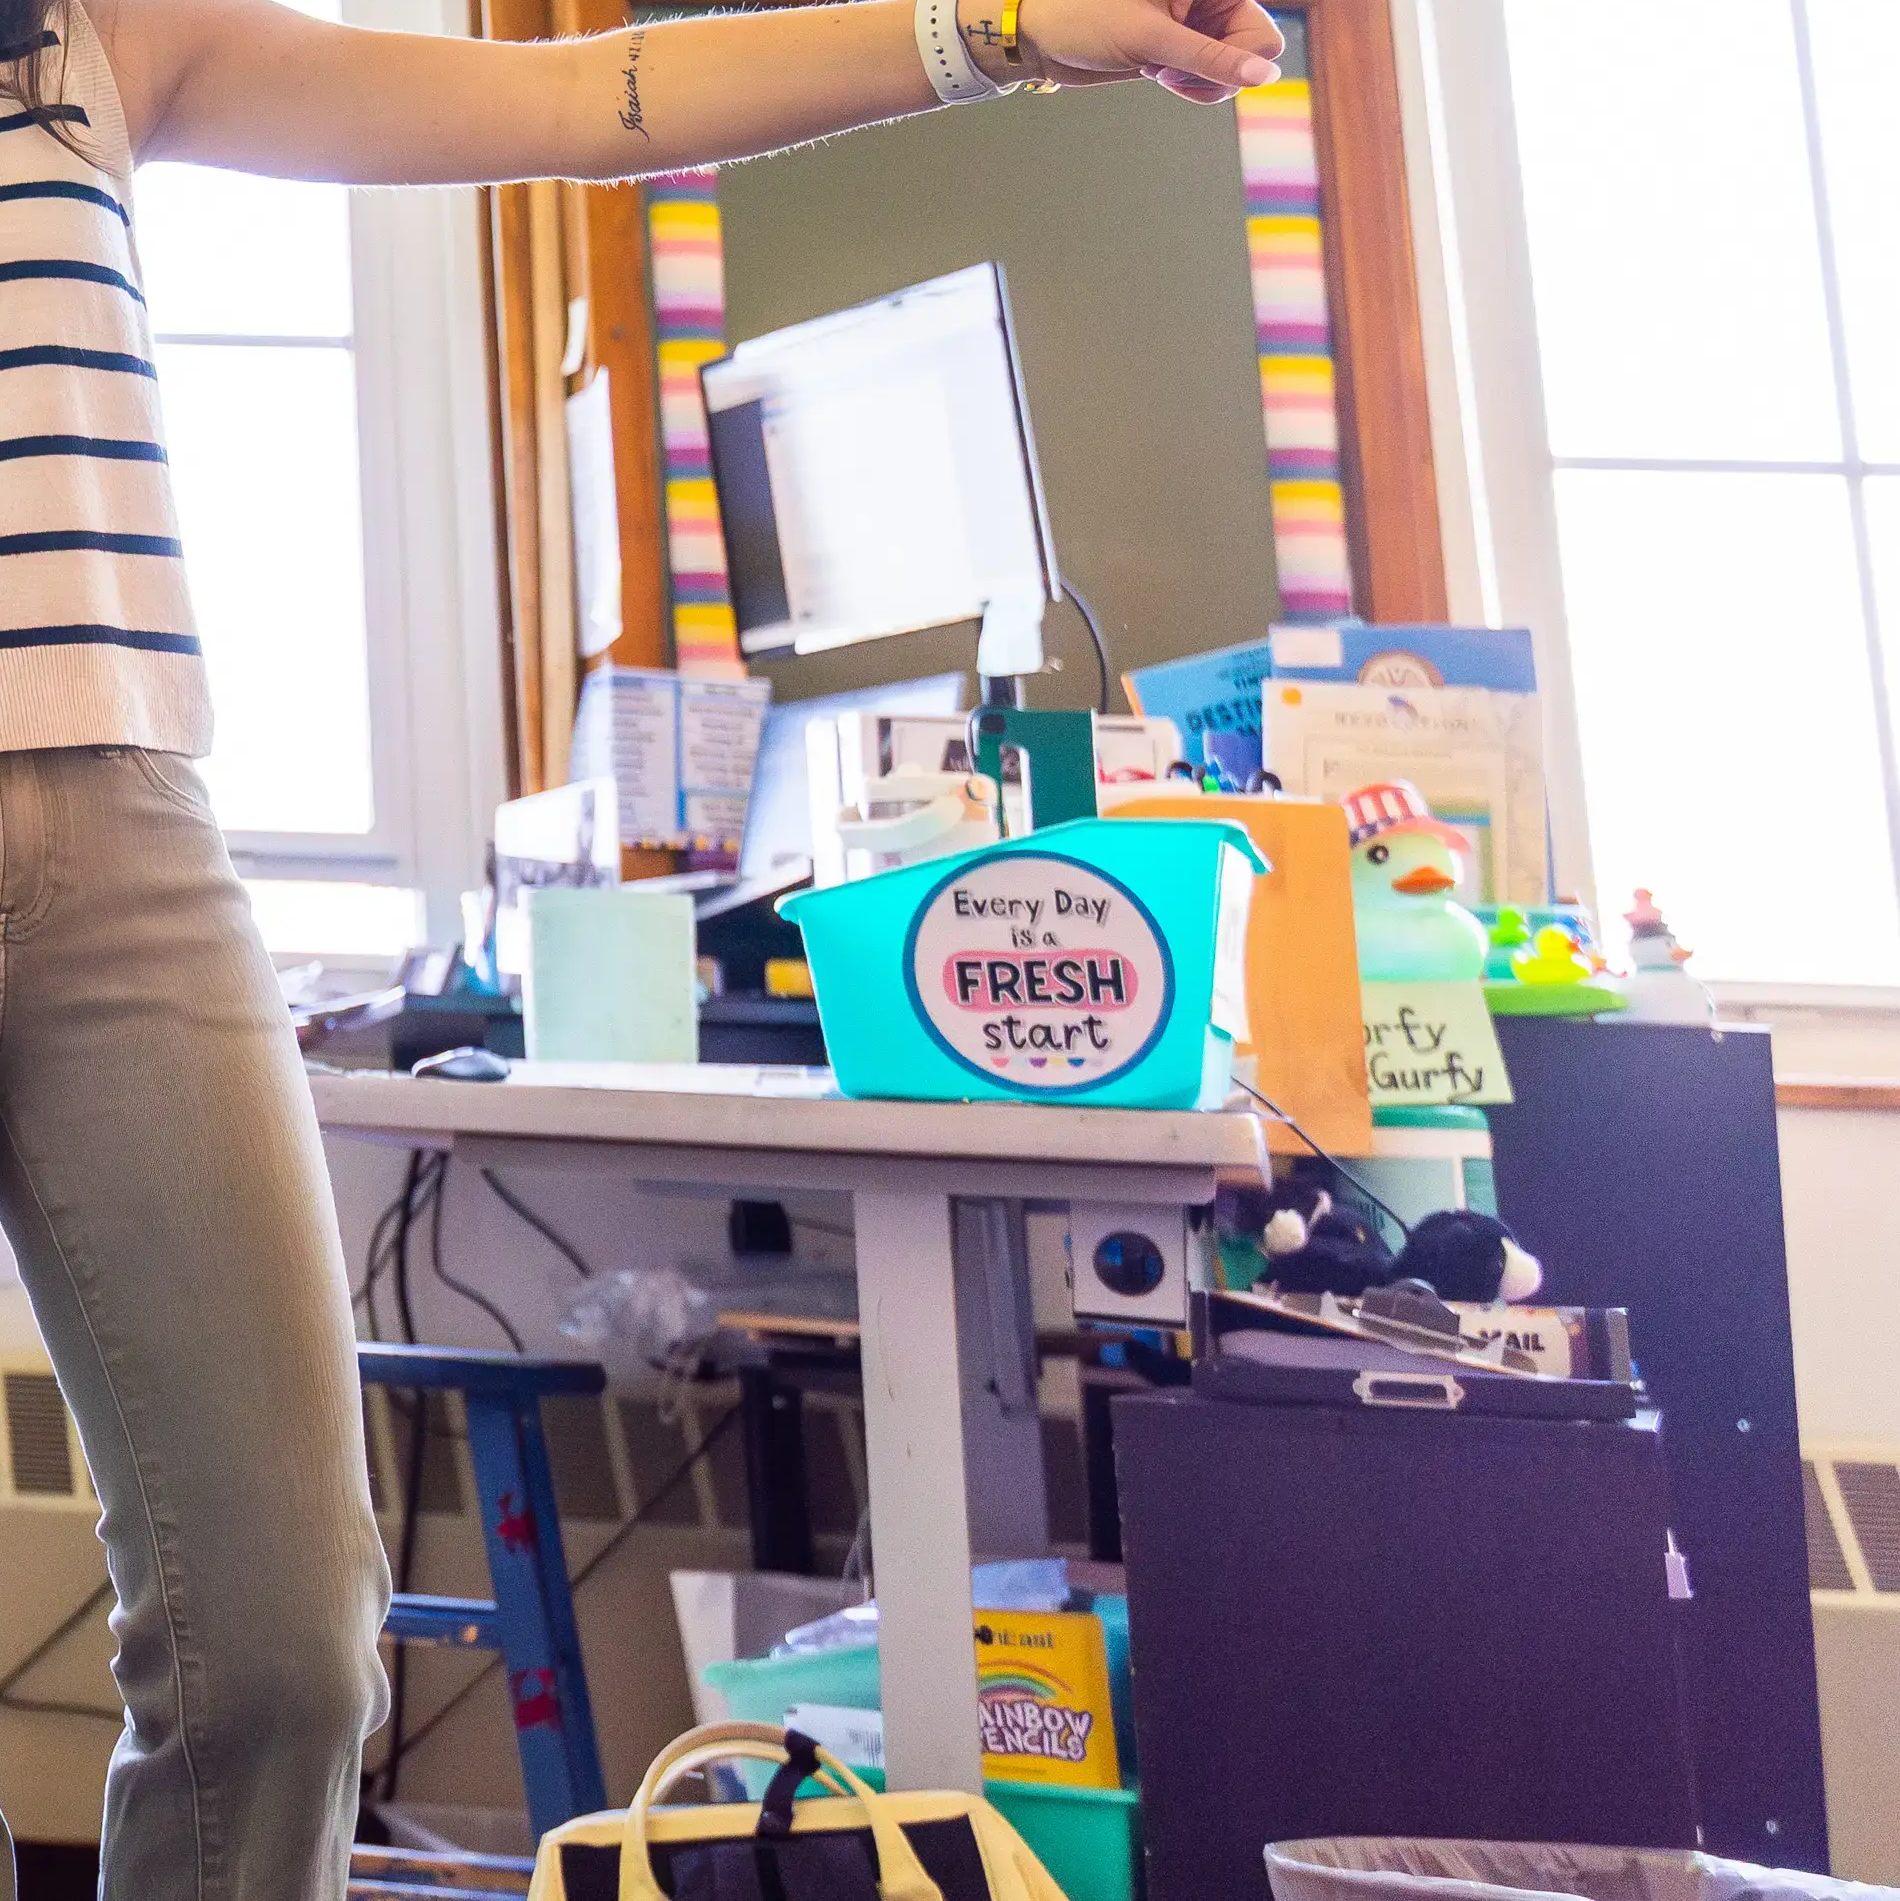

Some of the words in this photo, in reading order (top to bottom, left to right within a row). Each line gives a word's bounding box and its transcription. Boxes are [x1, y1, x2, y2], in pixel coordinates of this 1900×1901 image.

[618, 65, 650, 143] Isaiah
[953, 889, 1042, 923] Every
[1054, 888, 1110, 923] Day
[1011, 927, 1034, 948] is
[1042, 930, 1058, 947] a
[954, 957, 1126, 1005] FRESH
[983, 1015, 1109, 1050] start
[1369, 1052, 1483, 1104] Gurfy
[978, 1701, 1092, 1740] AINBOW
[981, 1726, 1087, 1763] ENCILS
